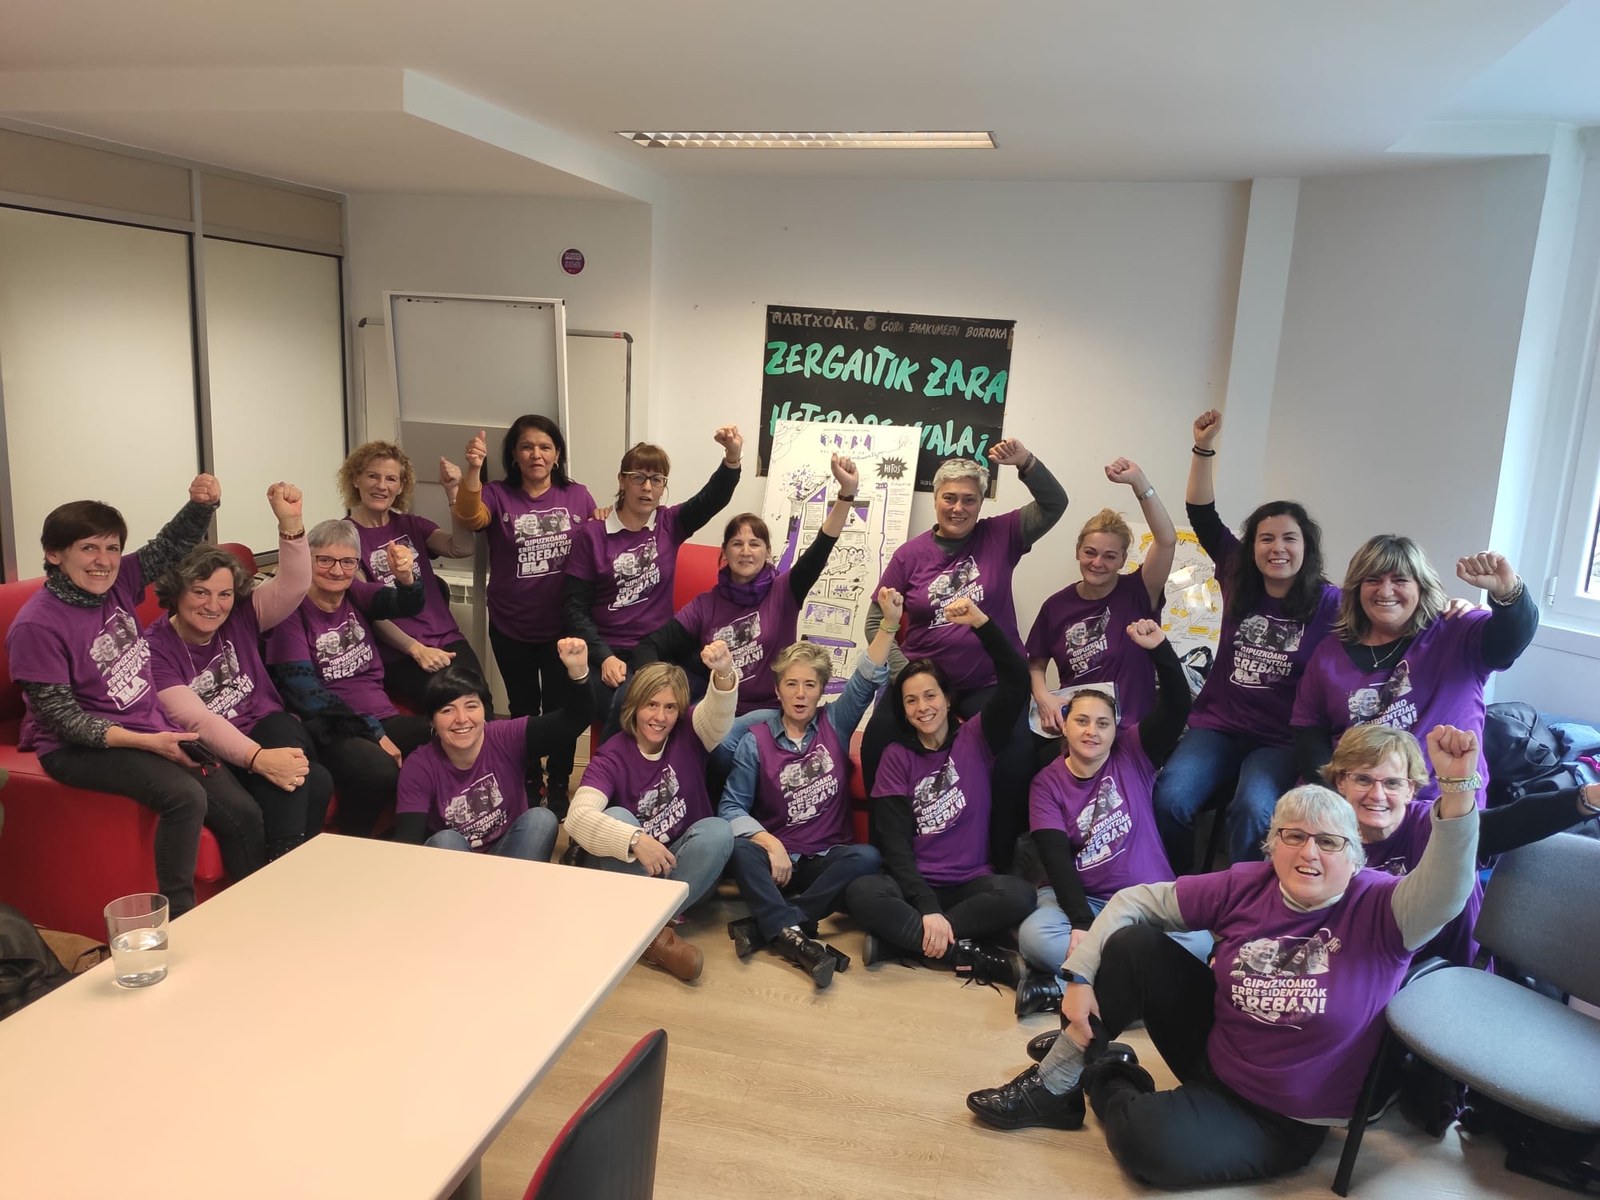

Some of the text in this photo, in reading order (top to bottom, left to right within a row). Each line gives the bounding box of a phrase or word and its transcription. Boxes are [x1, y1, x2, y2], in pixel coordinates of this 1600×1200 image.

[863, 315, 877, 331] 8
[881, 321, 904, 333] GORA
[908, 322, 960, 337] EMAKUMEEN
[965, 326, 1008, 340] BORROKA
[764, 341, 1008, 404] ZERGAITIK ZARA
[883, 463, 902, 474] HITOS
[518, 539, 573, 554] ERRESIDENTZIAK
[524, 533, 568, 547] GIPUZKOAKO
[517, 545, 572, 563] GREBAN!
[1240, 646, 1288, 662] GIPUZKOAKO
[1233, 657, 1292, 676] GREBAN!
[1091, 810, 1123, 835] UZKOAKO
[1231, 984, 1328, 997] ERRESIDENTZIAK
[1243, 978, 1318, 989] GIPUZKOAKO
[1231, 994, 1327, 1014] GREBAN!
